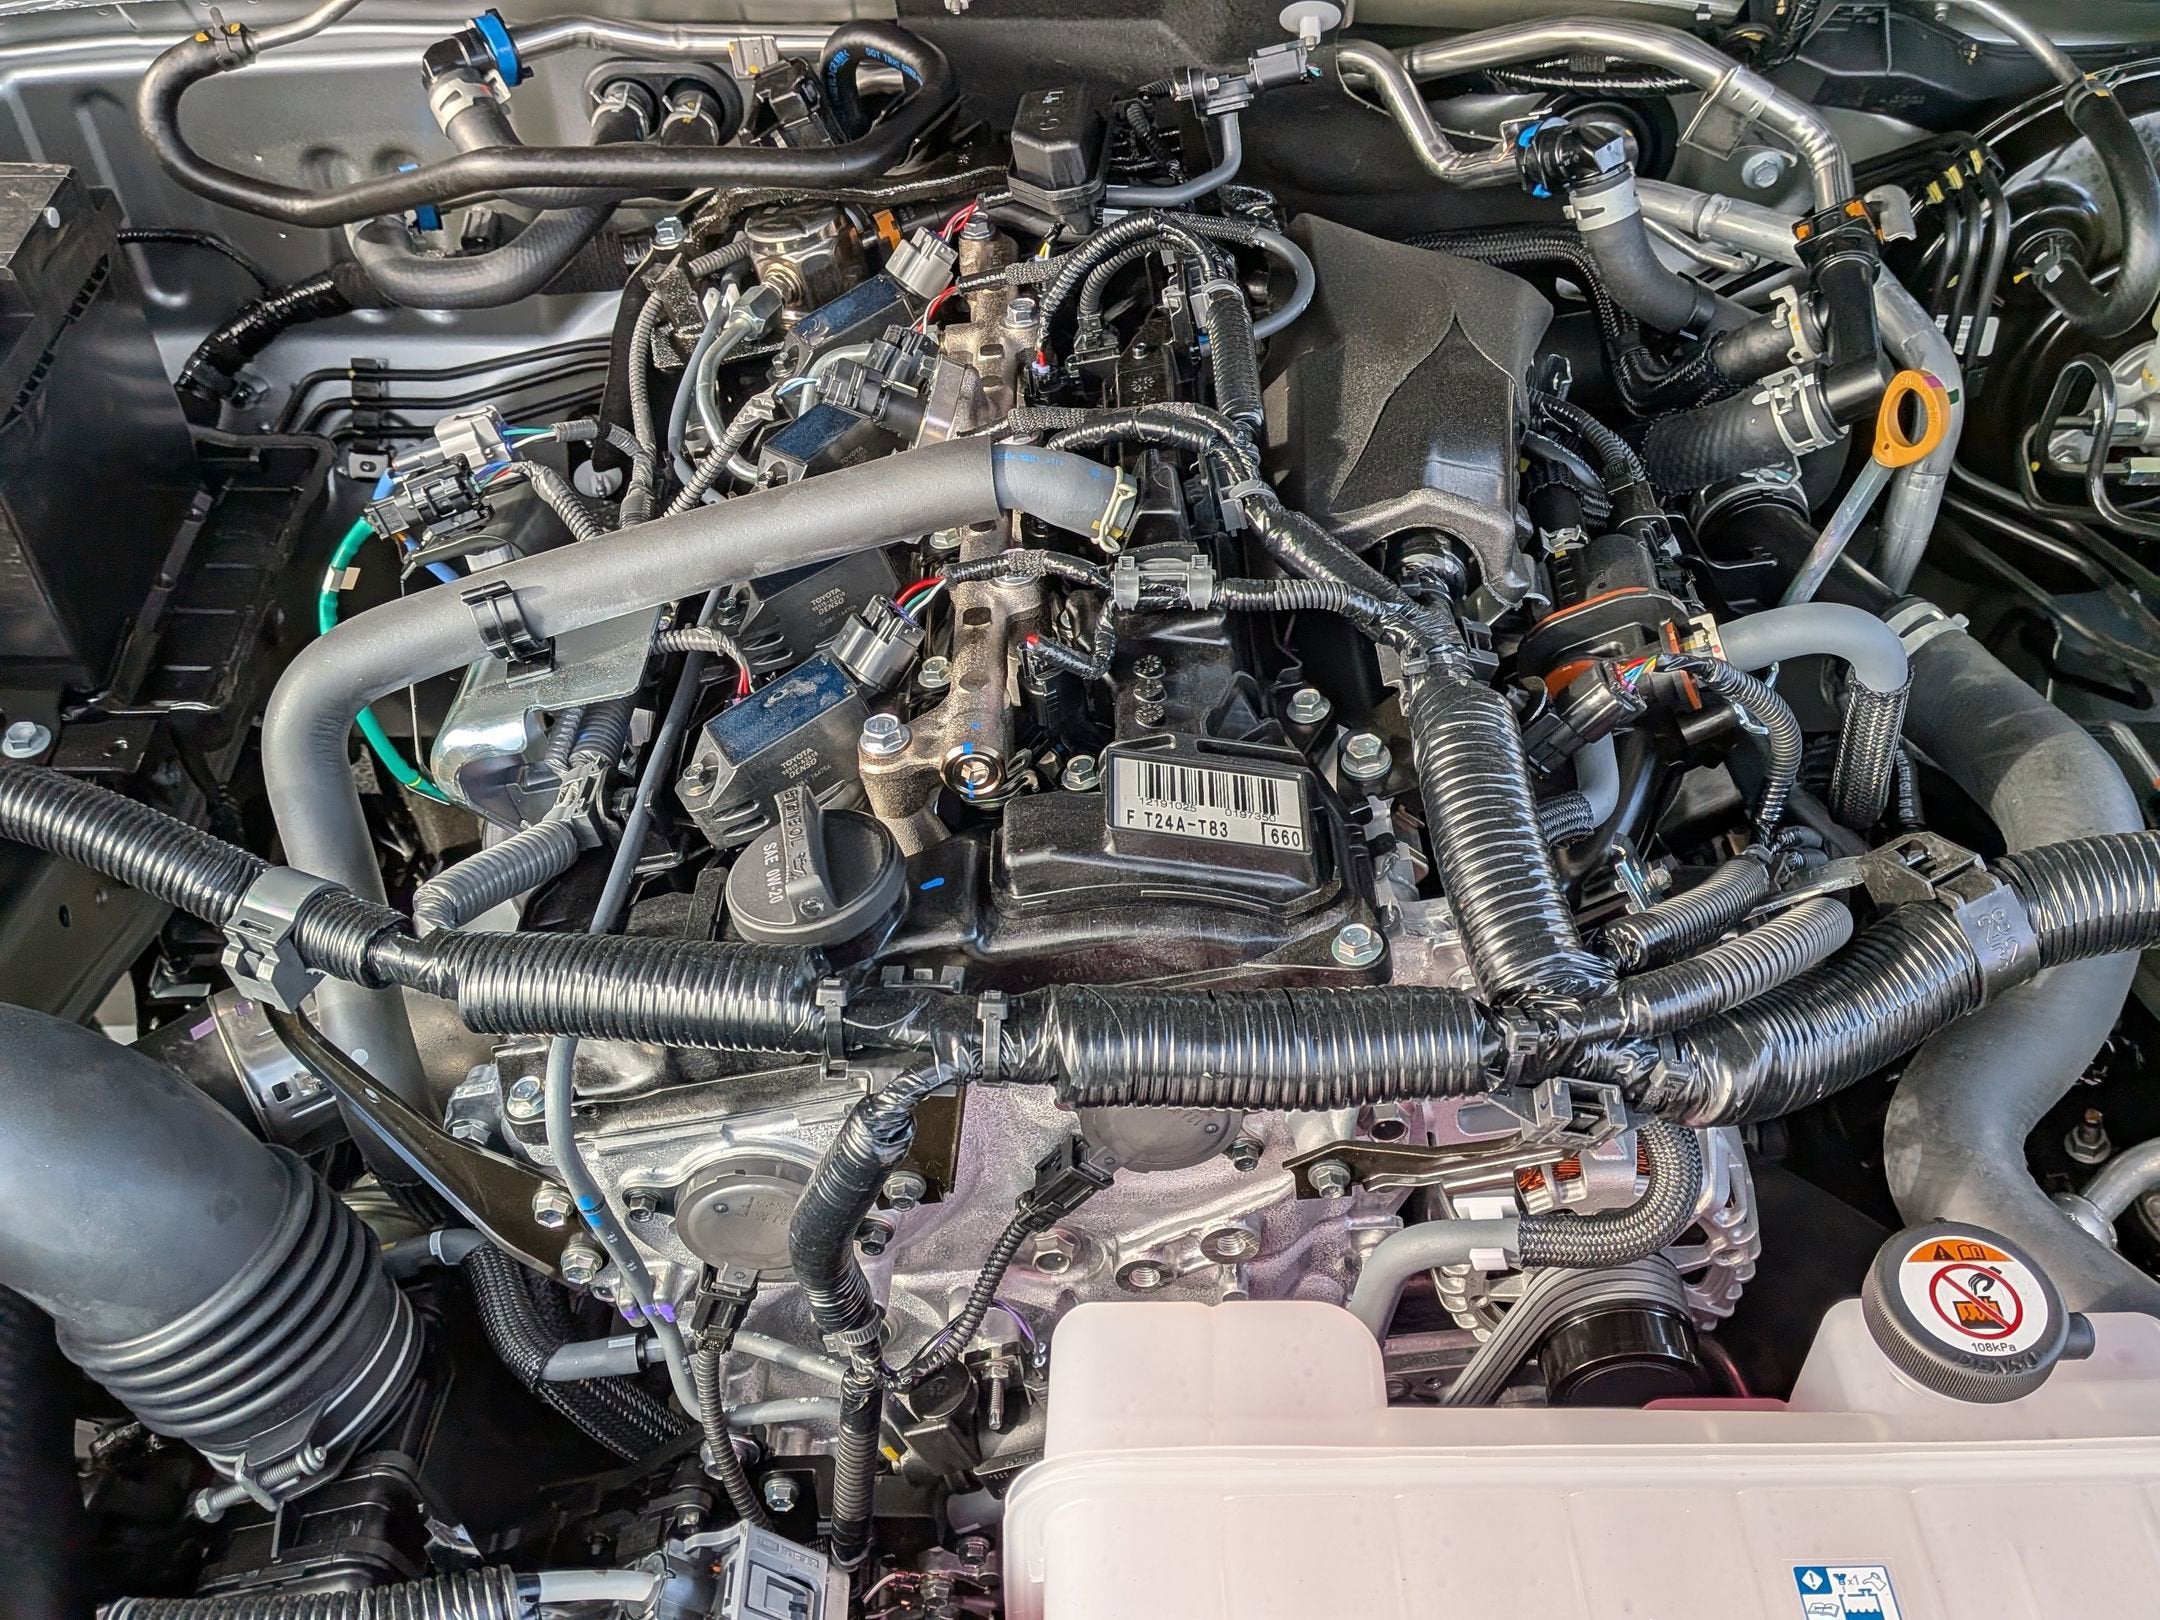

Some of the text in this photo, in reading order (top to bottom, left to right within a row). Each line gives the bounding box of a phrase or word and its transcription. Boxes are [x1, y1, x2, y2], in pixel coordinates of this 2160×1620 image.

[840, 446, 864, 464] TOYOTA
[810, 587, 841, 606] TOYOTA
[818, 597, 845, 616] DENSO
[780, 747, 814, 768] TOYOTA
[789, 757, 817, 779] DENSO
[1139, 797, 1197, 812] 12191025
[1127, 809, 1229, 838] F T24A-T83
[1224, 808, 1277, 822] 0197350
[787, 828, 804, 848] OIL
[1270, 828, 1300, 847] 660
[763, 841, 784, 905] SAE 0W-20
[1971, 1342, 2017, 1353] 108kPa
[1954, 1351, 2038, 1376] DENSO
